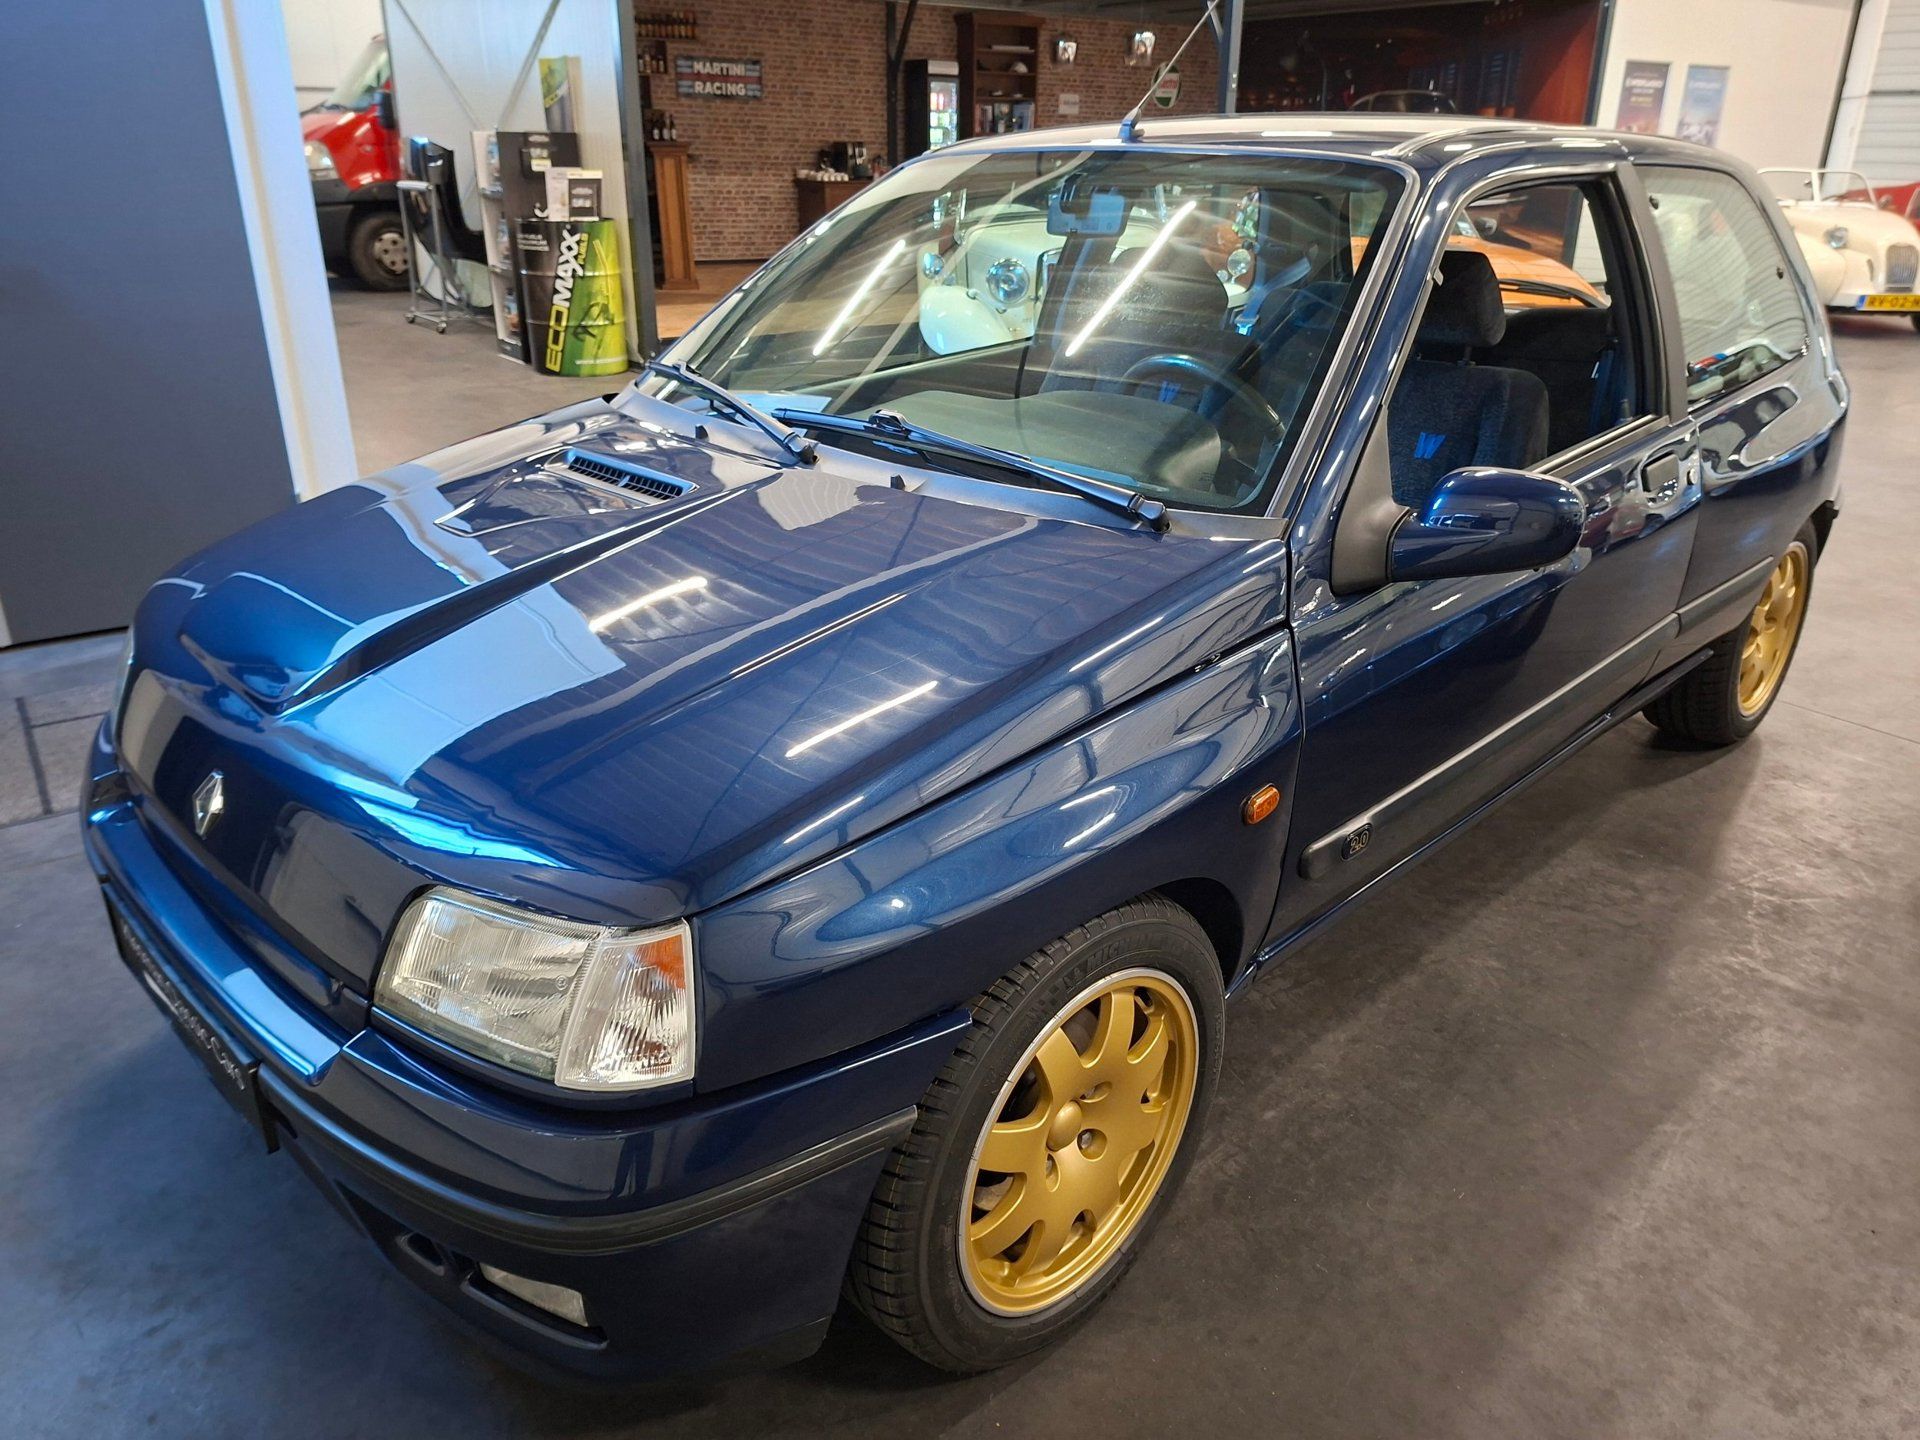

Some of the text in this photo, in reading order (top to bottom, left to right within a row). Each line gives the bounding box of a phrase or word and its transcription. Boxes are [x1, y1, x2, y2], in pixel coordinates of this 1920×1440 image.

[693, 61, 745, 76] MARTINI
[694, 81, 746, 96] RACING
[545, 228, 584, 372] ECOMAXX
